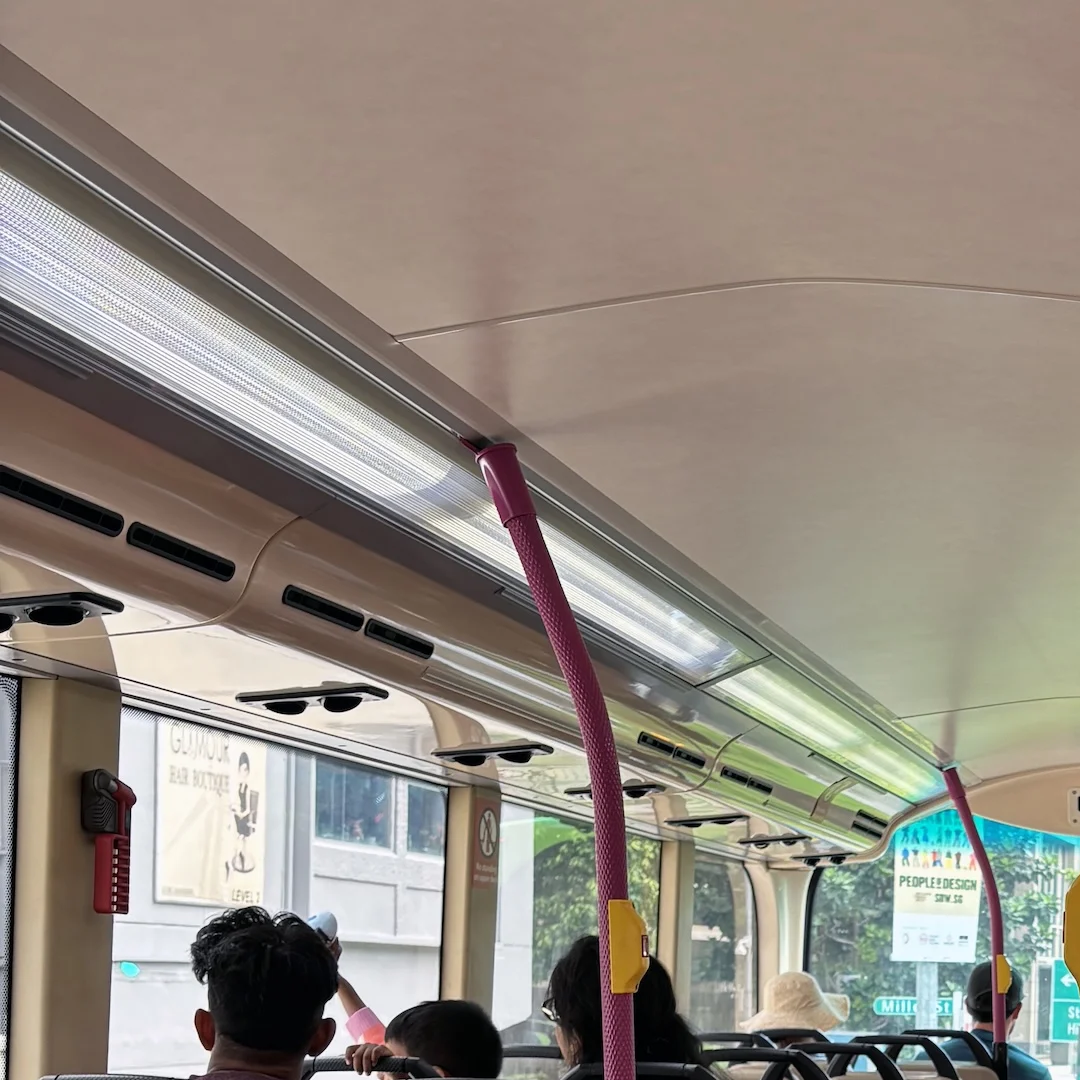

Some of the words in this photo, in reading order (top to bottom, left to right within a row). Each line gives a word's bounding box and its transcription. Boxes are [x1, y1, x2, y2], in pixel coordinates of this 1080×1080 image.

[169, 764, 188, 785] HAIR
[899, 875, 935, 889] PEOPLE
[943, 878, 977, 891] DESIGN
[231, 888, 253, 904] LEVEL
